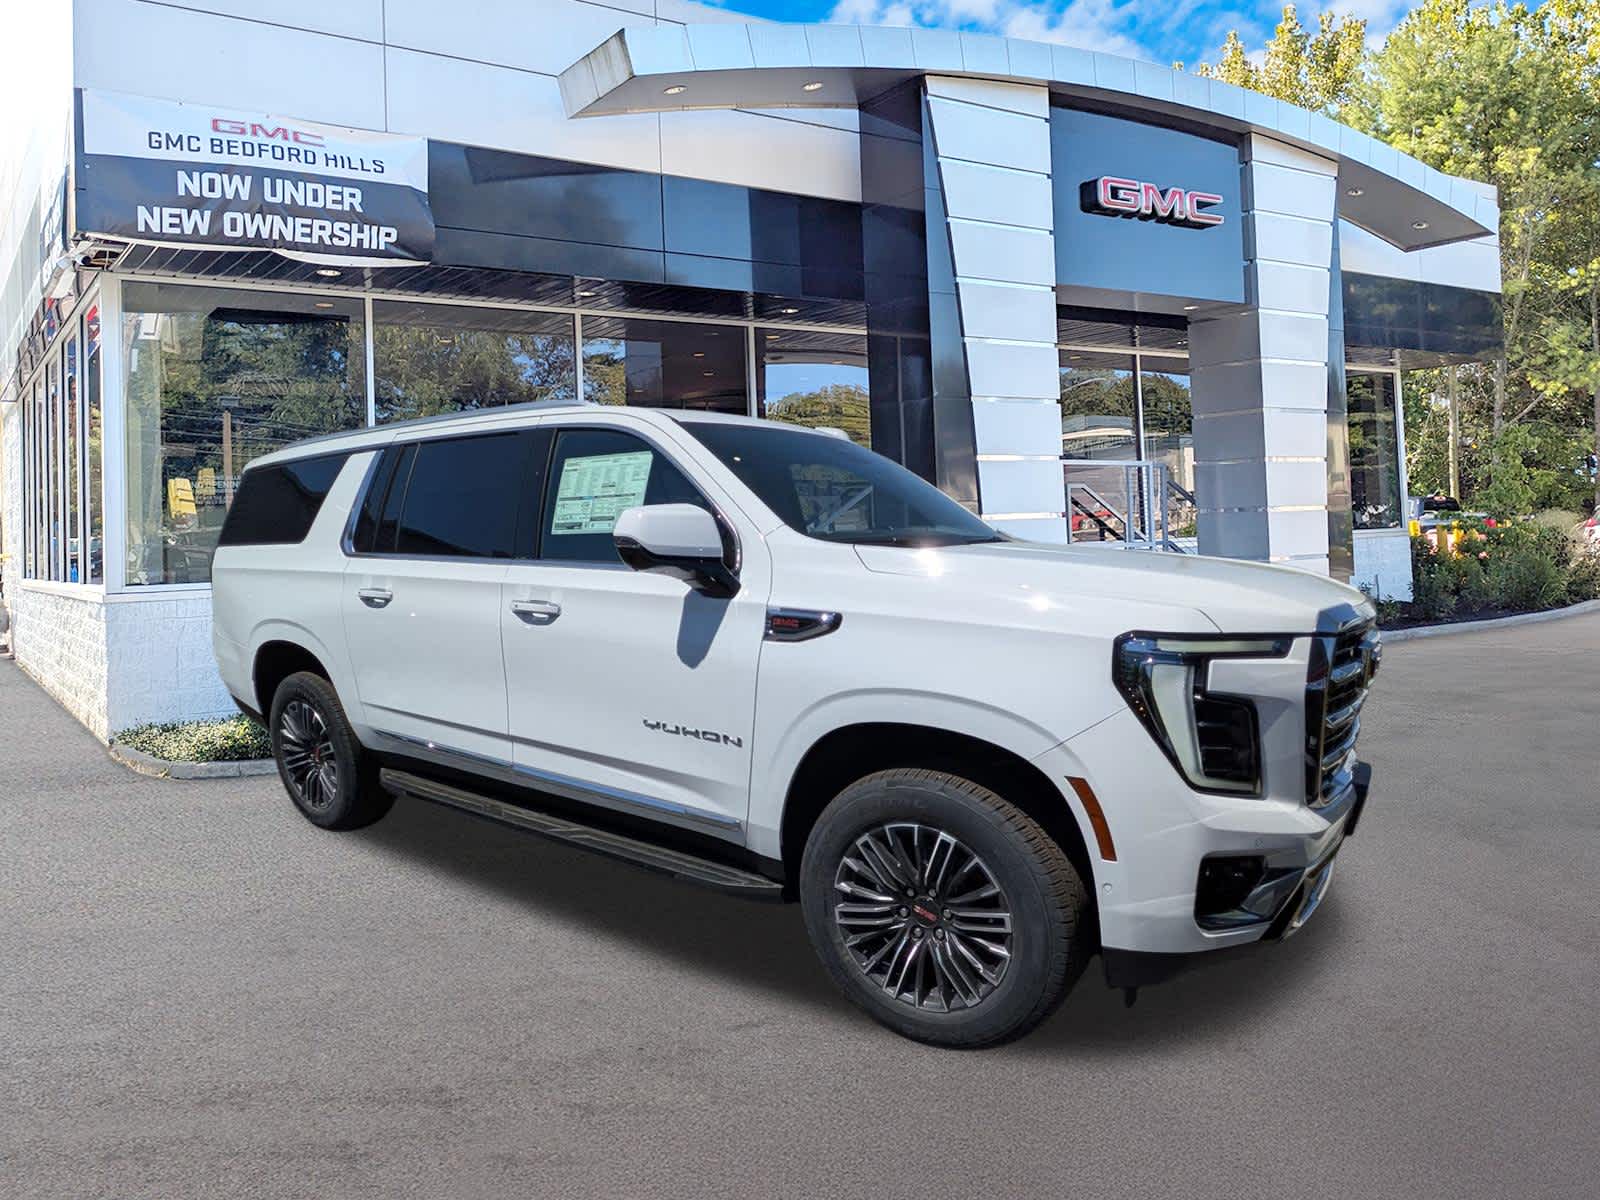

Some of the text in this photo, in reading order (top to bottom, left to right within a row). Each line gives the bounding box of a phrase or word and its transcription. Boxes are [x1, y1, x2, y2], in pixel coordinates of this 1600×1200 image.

[148, 131, 385, 174] GMC BEDFORD HILLS
[210, 118, 326, 148] GMC
[176, 170, 363, 213] NOW UNDER
[1097, 175, 1225, 225] GMC
[136, 205, 398, 250] NEW OWNERSHIP
[642, 719, 743, 748] YUKON
